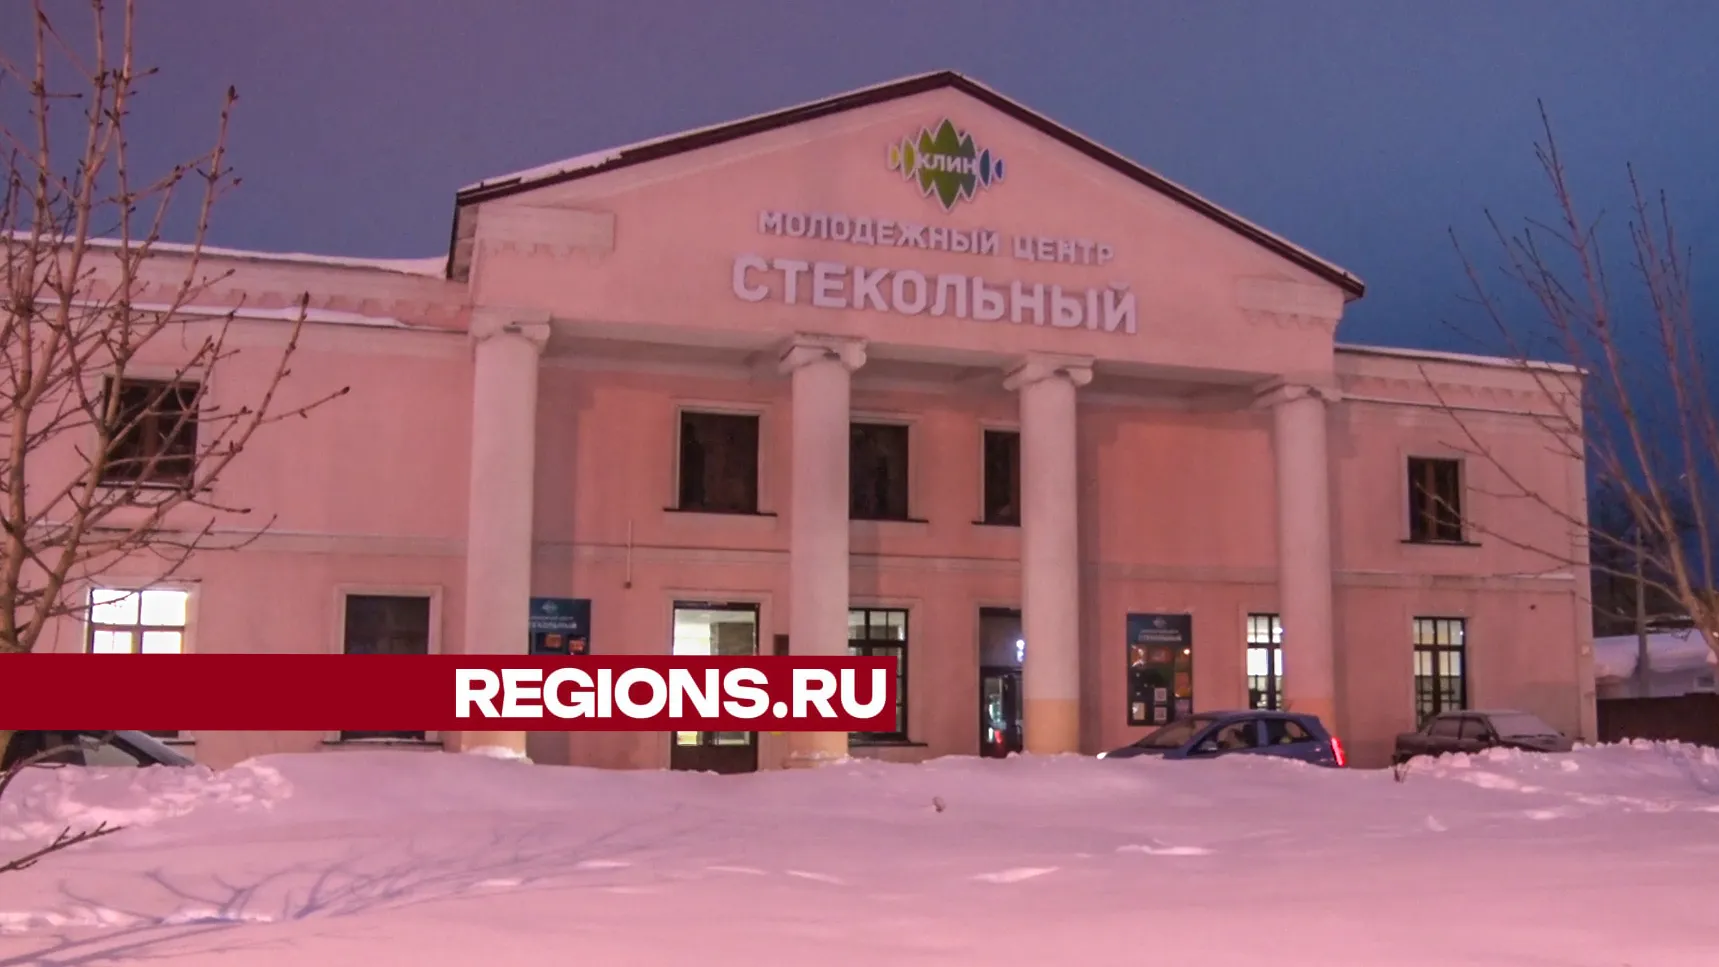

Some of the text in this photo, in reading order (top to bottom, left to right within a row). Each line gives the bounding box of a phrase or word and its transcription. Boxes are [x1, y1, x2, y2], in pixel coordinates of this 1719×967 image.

[917, 152, 977, 175] КЛИН
[759, 211, 1115, 266] МОЛОДЕЖНЫЙ ЦЕНТР
[733, 254, 1138, 334] СТЕКОЛЬНЫЙ
